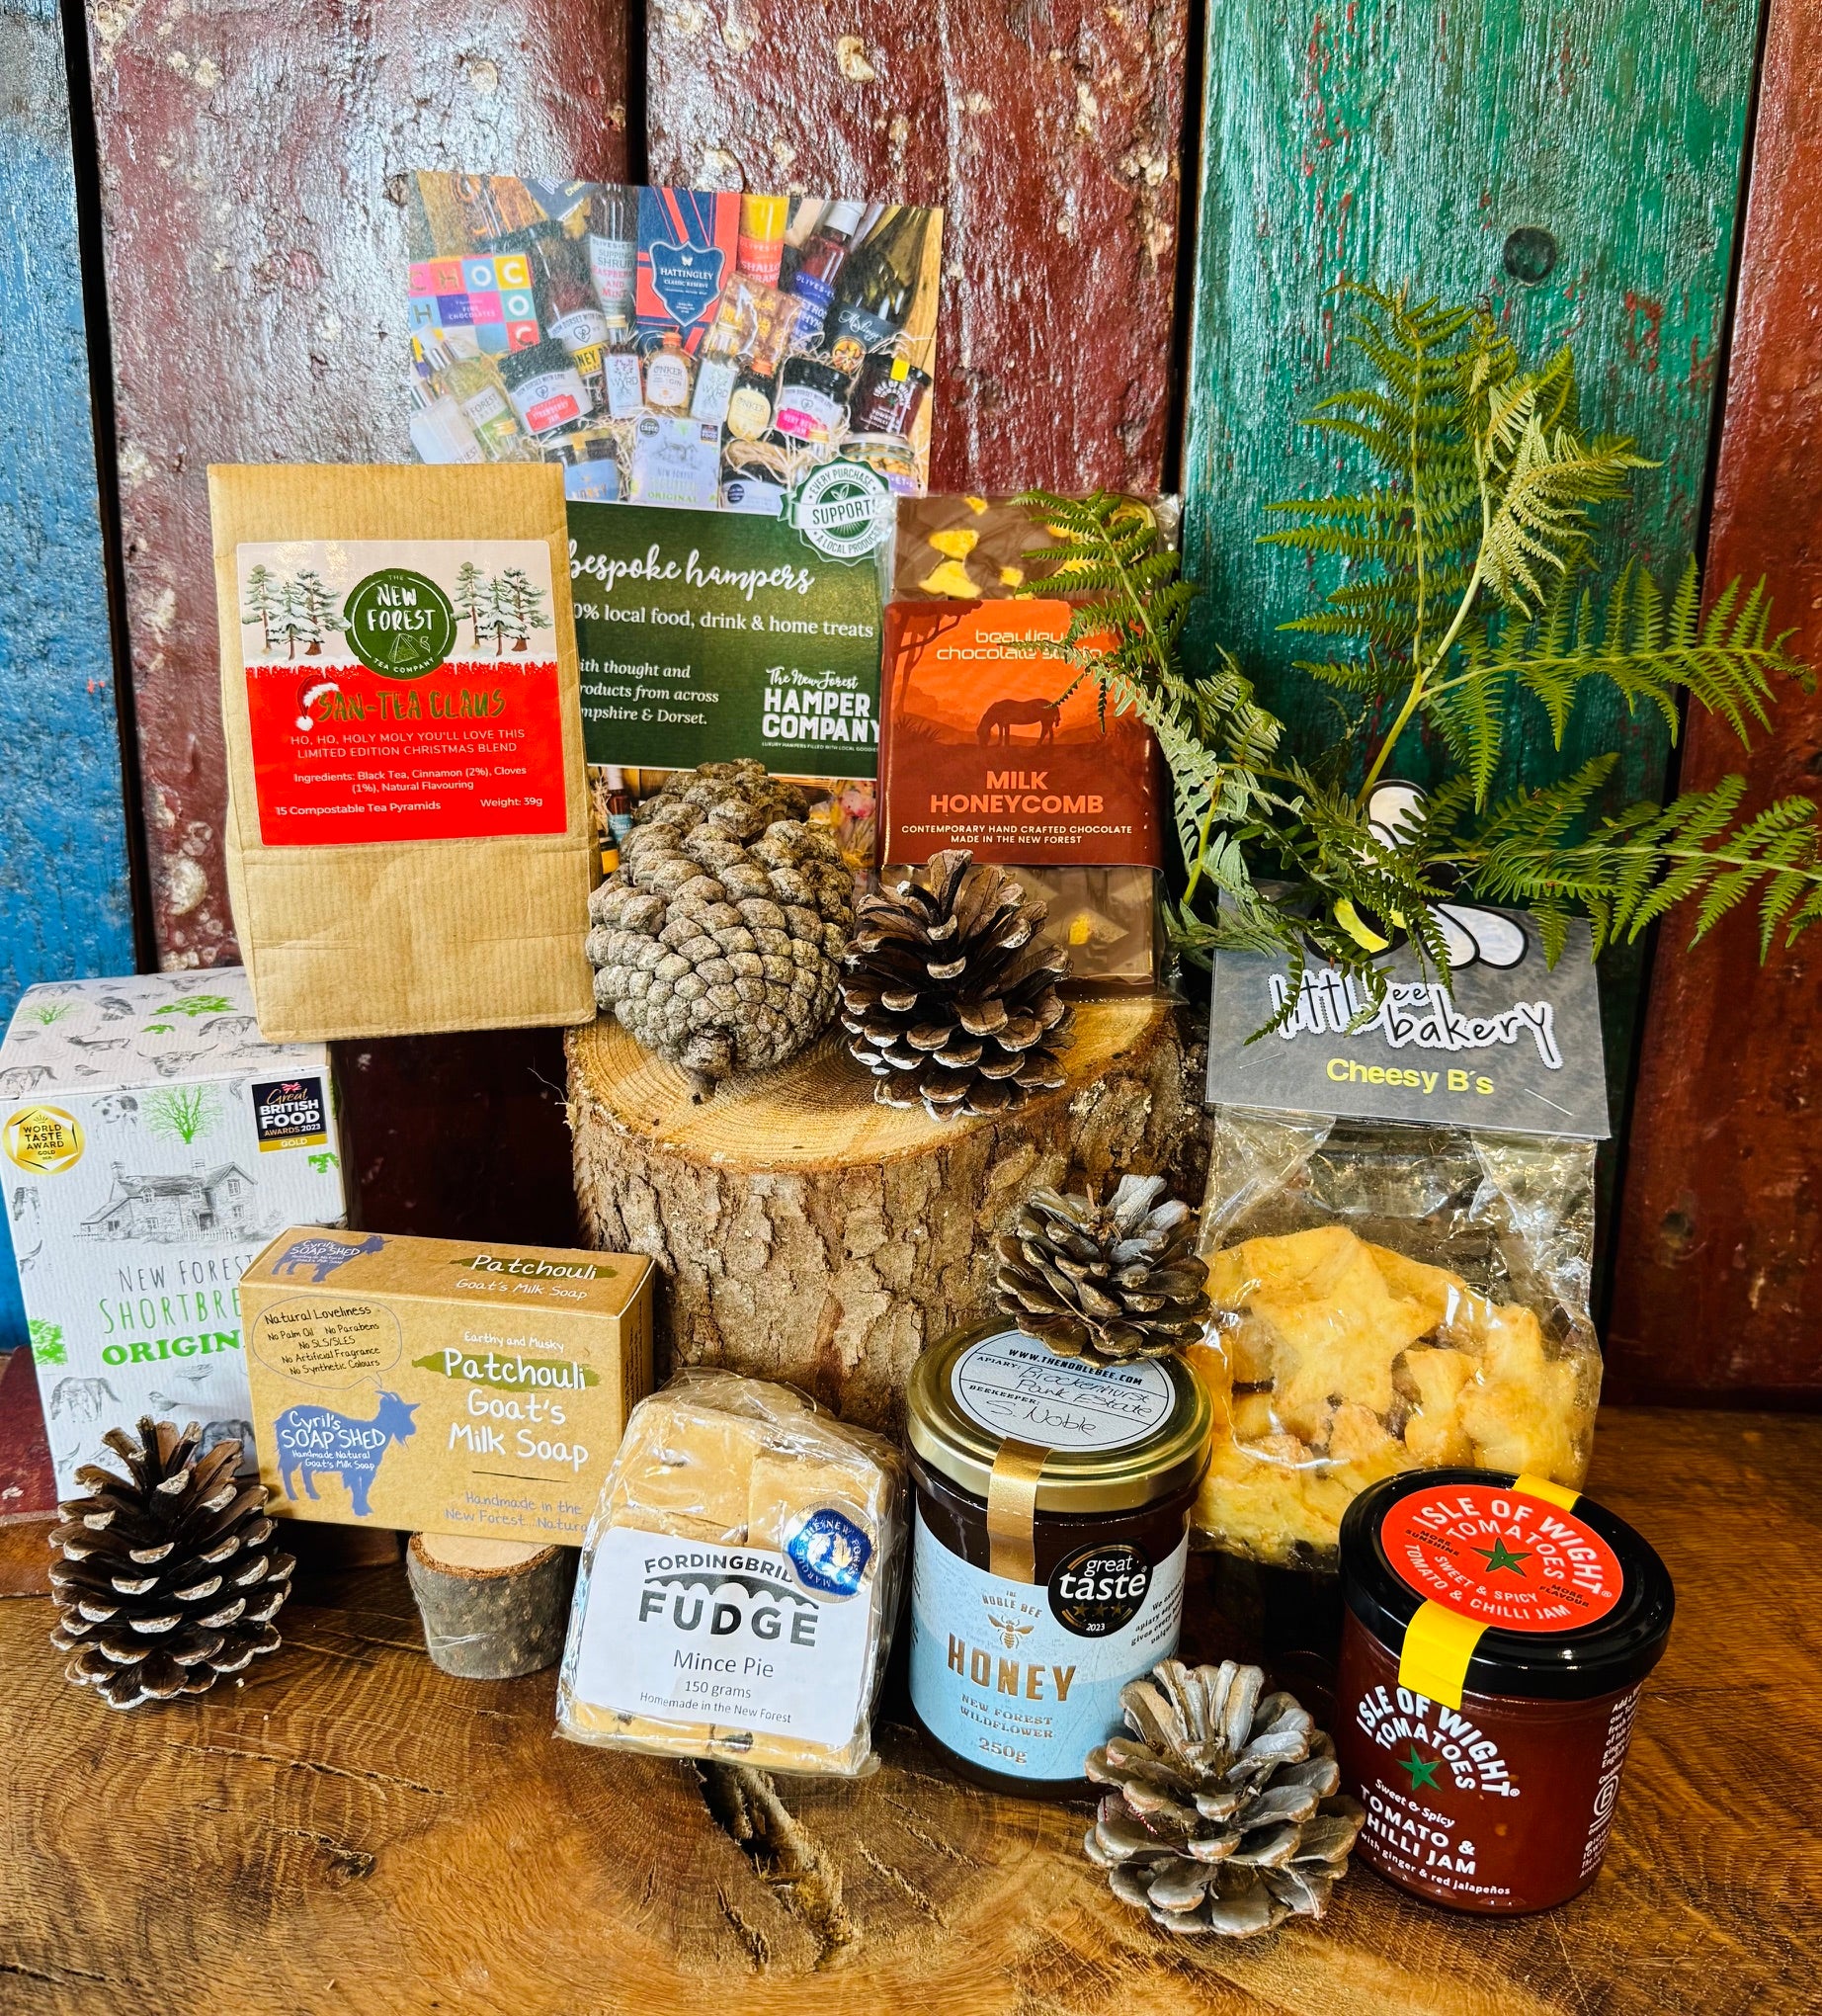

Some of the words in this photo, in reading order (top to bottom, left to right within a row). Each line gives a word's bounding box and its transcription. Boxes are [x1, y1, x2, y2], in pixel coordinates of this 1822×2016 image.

[660, 268, 713, 280] HATTINGLEY
[810, 471, 834, 494] EVERY
[833, 468, 873, 487] PURCHASE
[648, 492, 697, 502] ORIGINAL
[812, 499, 875, 525] SUPPORT
[822, 540, 847, 553] LOCAL
[849, 528, 878, 553] PRODUCE
[568, 539, 682, 592] bespoke
[685, 548, 816, 602] hampers
[377, 584, 417, 607] NEW
[368, 609, 436, 631] FOREST
[573, 603, 600, 621] 0%
[604, 604, 645, 624] local
[650, 608, 695, 629] food,
[701, 612, 746, 630] drink
[751, 615, 765, 631] &
[769, 616, 818, 633] home
[823, 621, 873, 637] treats
[975, 630, 1064, 643] beaulieu
[373, 658, 389, 670] TEA
[393, 657, 435, 673] COMPANY
[766, 666, 790, 685] The
[791, 669, 819, 686] New
[817, 670, 859, 690] Forest
[316, 689, 422, 722] SAN-TEA
[429, 689, 506, 719] CLAUS
[764, 688, 870, 717] HAMPER
[290, 736, 313, 745] HO,
[317, 735, 339, 744] HO,
[343, 734, 375, 743] HOLY
[380, 733, 414, 742] MOLY
[417, 731, 459, 741] YOU'LL
[463, 730, 494, 739] LOVE
[498, 729, 525, 738] THIS
[762, 714, 880, 743] COMPANY
[297, 748, 346, 758] LIMITED
[350, 747, 399, 757] EDITION
[403, 744, 474, 755] CHRISTMAS
[478, 743, 517, 753] BLEND
[293, 773, 355, 784] Ingredients:
[358, 771, 385, 780] Black
[387, 771, 409, 780] Tea,
[412, 769, 462, 779] Cinnamon
[465, 768, 492, 778] (2%),
[987, 771, 1048, 790] MILK
[480, 798, 522, 807] Weight:
[524, 797, 543, 806] 39g
[930, 795, 1104, 814] HONEYCOMB
[1021, 825, 1066, 834] CRAFTED
[1069, 825, 1132, 834] CHOCOLATE
[1387, 987, 1556, 1062] bakery
[1326, 1057, 1439, 1094] Cheesy
[260, 1099, 318, 1115] BRITISH
[267, 1088, 308, 1105] Great
[23, 1125, 61, 1134] WORLD
[262, 1111, 319, 1129] FOOD
[264, 1127, 300, 1136] AWARDS
[25, 1133, 62, 1141] TASTE
[119, 1264, 166, 1293] NEW
[471, 1255, 597, 1280] Patchouli
[456, 1279, 508, 1292] Goat's
[513, 1283, 544, 1294] Milk
[549, 1287, 587, 1301] Soap
[99, 1289, 240, 1334] SHORTBRE
[265, 1309, 311, 1324] Natural
[313, 1305, 372, 1319] Loveliness
[338, 1323, 379, 1333] Parabens
[102, 1330, 240, 1366] ORIGIN
[464, 1331, 503, 1346] Earthy
[506, 1335, 526, 1347] and
[529, 1337, 564, 1353] Musky
[443, 1348, 586, 1390] Patchouli
[976, 1356, 1023, 1370] APIARY:
[467, 1388, 566, 1425] Goat's
[290, 1411, 341, 1434] Cyril's
[282, 1429, 334, 1449] SOAP
[339, 1428, 385, 1450] SHED
[448, 1422, 506, 1456] Milk
[516, 1429, 589, 1472] Soap
[1412, 1497, 1480, 1531] ISLE
[1491, 1499, 1533, 1522] OF
[1538, 1516, 1604, 1596] WIGHT
[1446, 1519, 1565, 1580] TOMATOES
[644, 1554, 792, 1583] FORDINGBRI
[1084, 1554, 1133, 1577] great
[1058, 1572, 1147, 1601] taste
[1405, 1544, 1449, 1591] TOMATO
[1449, 1589, 1464, 1602] &
[1469, 1598, 1531, 1620] CHILLI
[1536, 1604, 1571, 1620] JAM
[1434, 1555, 1475, 1588] SWEET
[1475, 1584, 1488, 1596] &
[1494, 1590, 1538, 1604] SPICY
[638, 1590, 819, 1646] FUDGE
[1086, 1623, 1106, 1632] 2023
[674, 1649, 736, 1673] Mince
[744, 1657, 774, 1678] Pie
[948, 1632, 1077, 1702] HONEY
[685, 1680, 708, 1693] 150
[711, 1685, 751, 1699] grams
[640, 1692, 698, 1710] Homemade
[702, 1701, 710, 1711] in
[713, 1703, 731, 1713] the
[734, 1705, 757, 1717] New
[760, 1709, 791, 1723] Forest
[961, 1693, 989, 1714] NEW
[994, 1703, 1054, 1725] FOREST
[959, 1706, 1054, 1738] WILDFLOWER
[978, 1736, 1028, 1764] 250g
[1356, 1685, 1393, 1736] ISLE
[1396, 1686, 1431, 1719] OF
[1437, 1706, 1511, 1798] WIGHT
[1375, 1718, 1476, 1791] TOMATOES
[1375, 1779, 1407, 1806] Sweet
[1408, 1799, 1421, 1812] &
[1421, 1806, 1454, 1828] Spicy
[1360, 1785, 1450, 1848] TOMATO
[1458, 1840, 1476, 1856] &
[1366, 1812, 1421, 1858] HILLI
[1425, 1850, 1476, 1876] JAM
[1360, 1831, 1380, 1851] with
[1381, 1849, 1417, 1873] ginger
[1419, 1868, 1428, 1878] &
[1431, 1874, 1450, 1887] red
[1452, 1880, 1511, 1895] jalapeños
